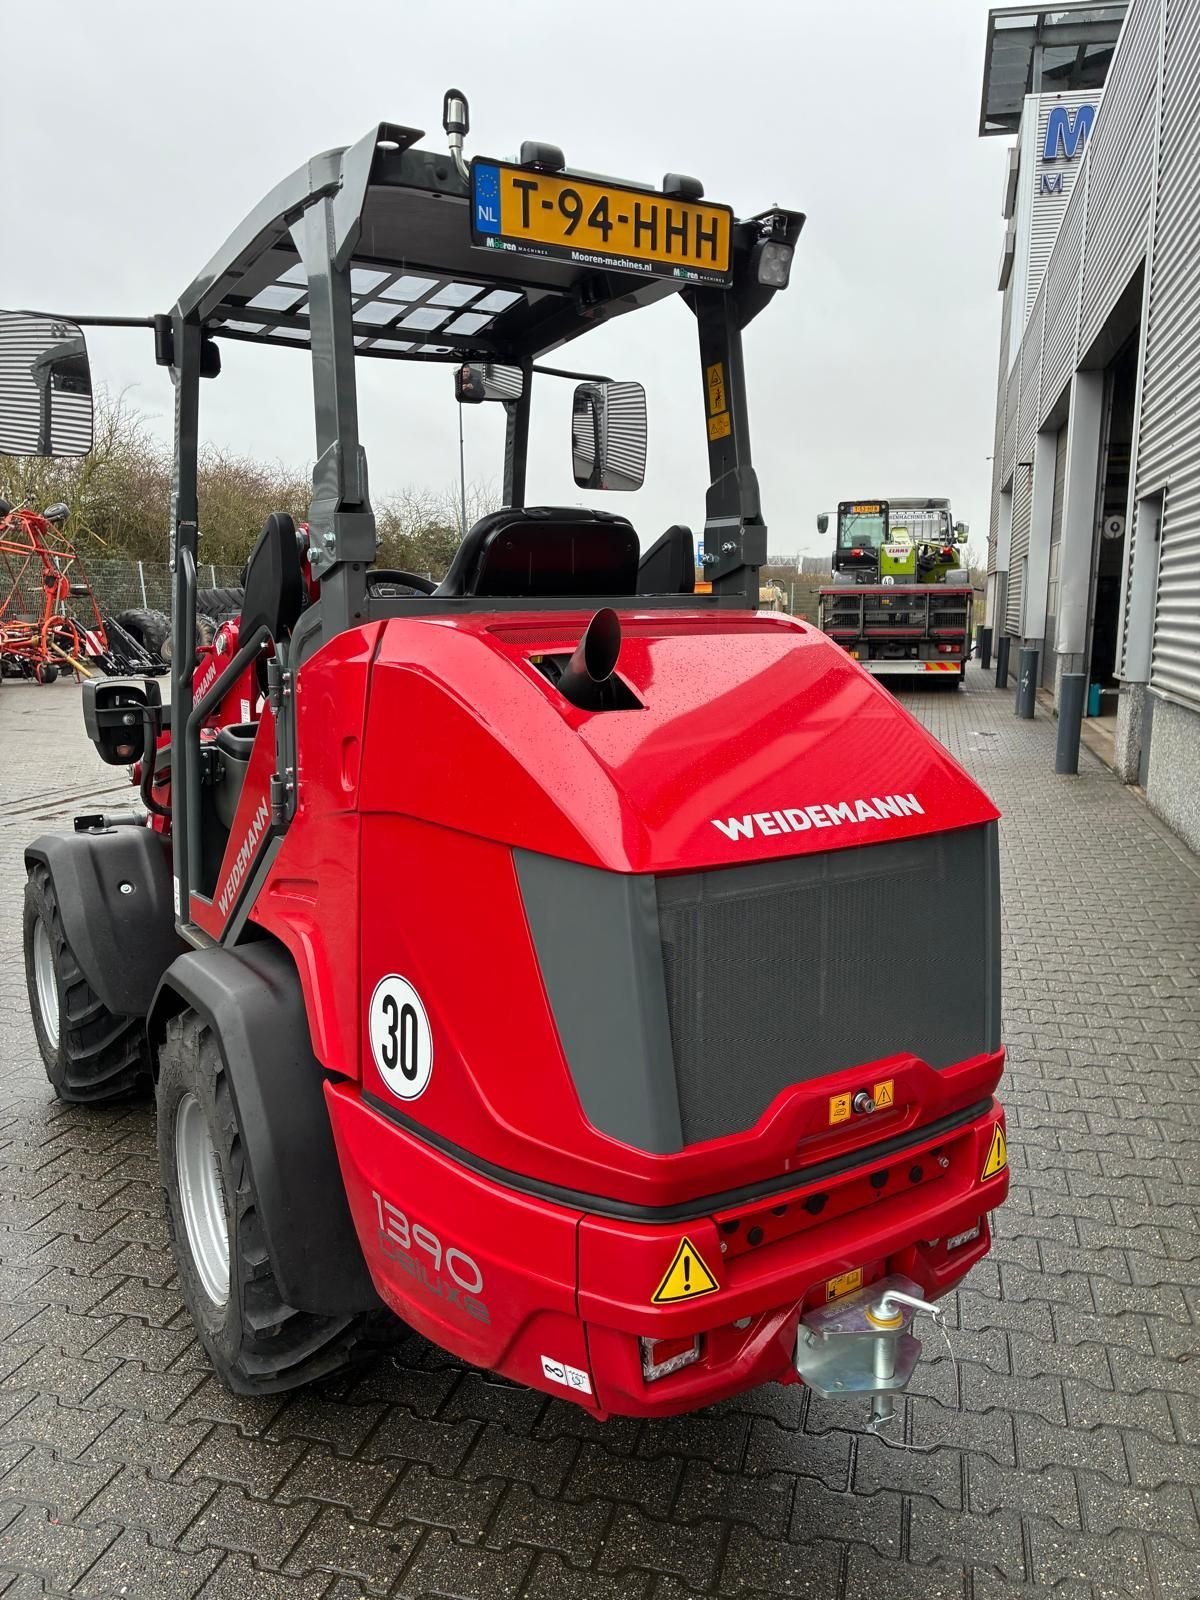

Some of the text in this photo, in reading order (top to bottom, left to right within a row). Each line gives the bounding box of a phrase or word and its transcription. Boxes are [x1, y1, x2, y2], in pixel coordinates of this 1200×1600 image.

[478, 205, 498, 223] NL
[512, 178, 718, 261] T-94-HHH
[518, 246, 548, 255] MACHINES
[571, 251, 652, 272] Mooren-machines.nl
[193, 661, 217, 707] DEMANN
[711, 793, 925, 841] WEIDEMANN
[218, 796, 269, 917] WEIDEMANN
[382, 994, 418, 1081] 30
[372, 1190, 483, 1294] 1390
